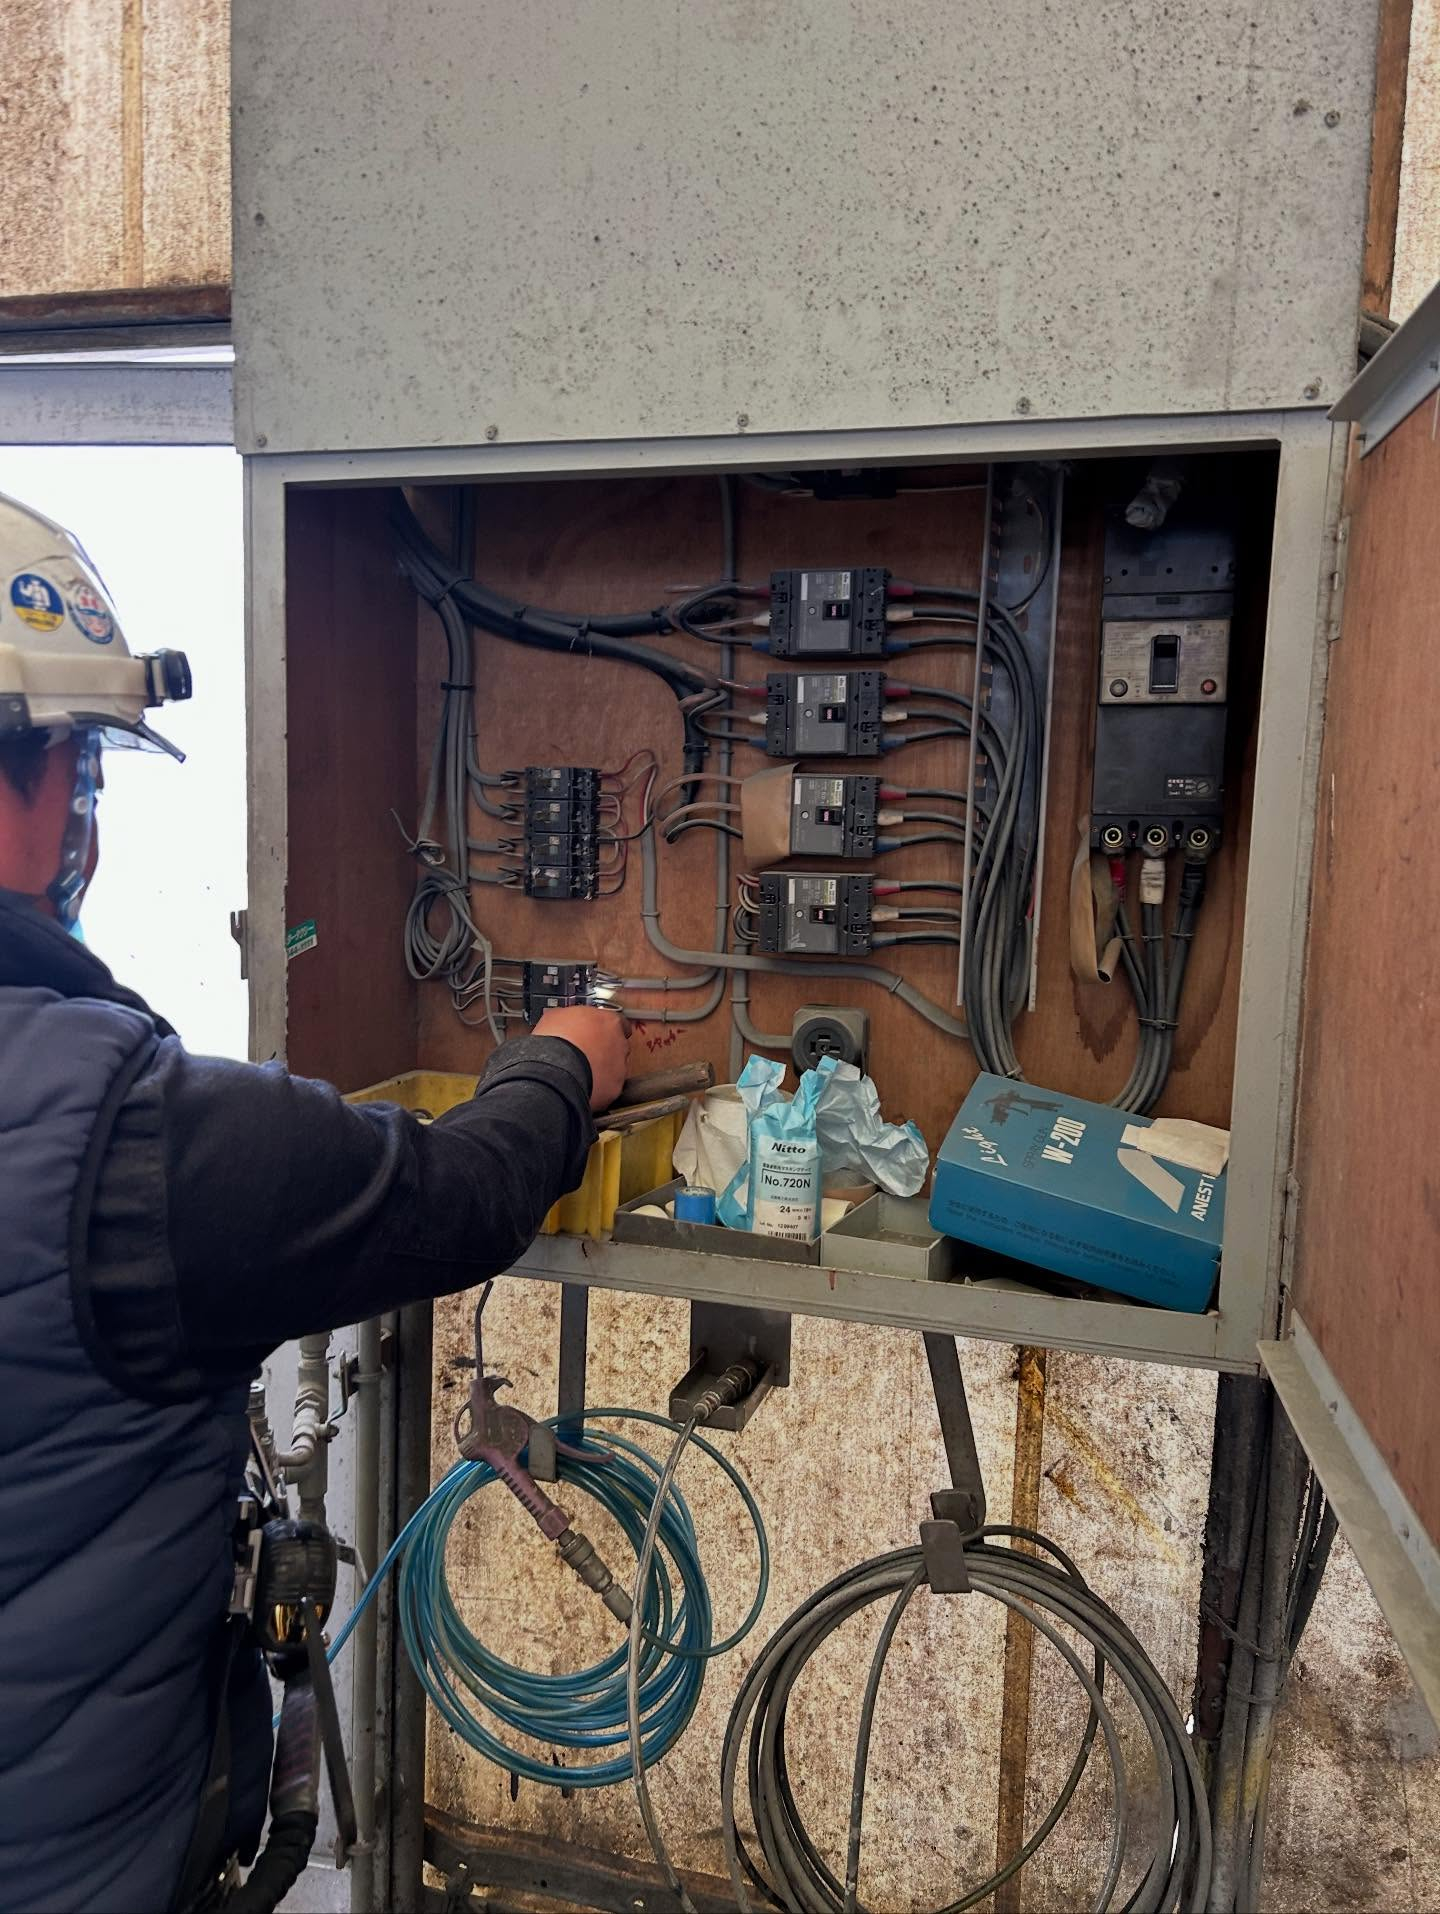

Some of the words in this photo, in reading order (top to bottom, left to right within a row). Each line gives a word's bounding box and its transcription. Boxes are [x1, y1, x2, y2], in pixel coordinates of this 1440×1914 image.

[771, 1142, 807, 1154] Nitto
[961, 1125, 1008, 1167] Light
[1041, 1116, 1087, 1165] W-200
[764, 1174, 812, 1189] No.720N
[779, 1205, 791, 1213] 24
[1190, 1179, 1214, 1222] ANEST
